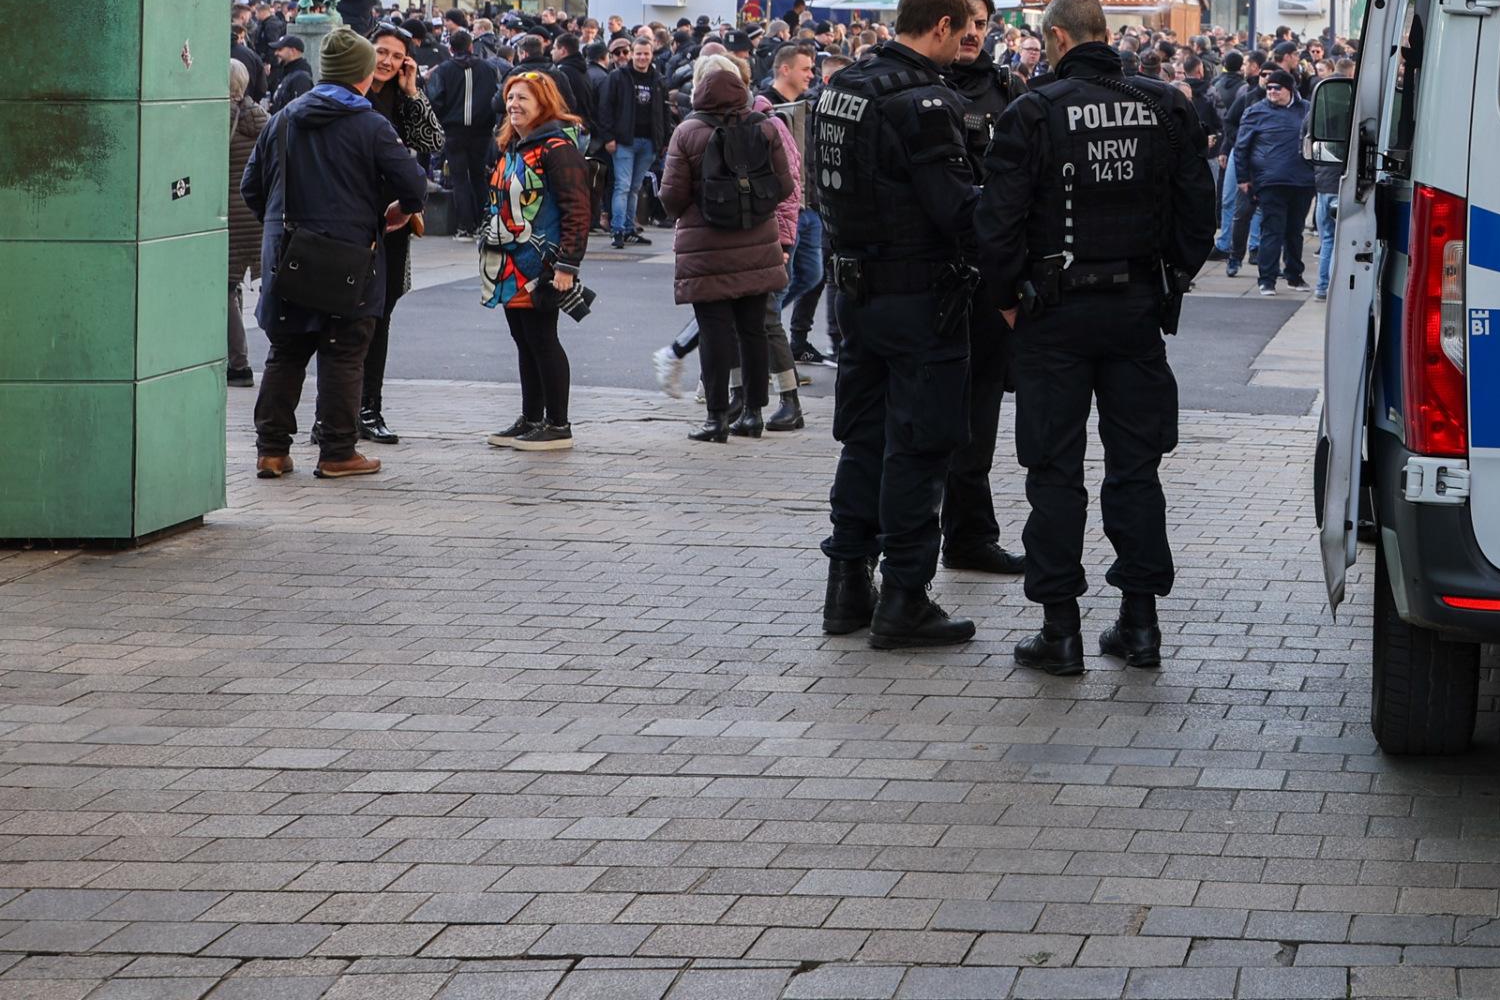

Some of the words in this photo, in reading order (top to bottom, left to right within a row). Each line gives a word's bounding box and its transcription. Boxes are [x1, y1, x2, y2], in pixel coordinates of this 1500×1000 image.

[1067, 101, 1158, 131] POLIZEI
[819, 121, 846, 145] NRW
[820, 145, 842, 166] 1413
[1087, 138, 1138, 161] NRW
[1091, 160, 1134, 182] 1413
